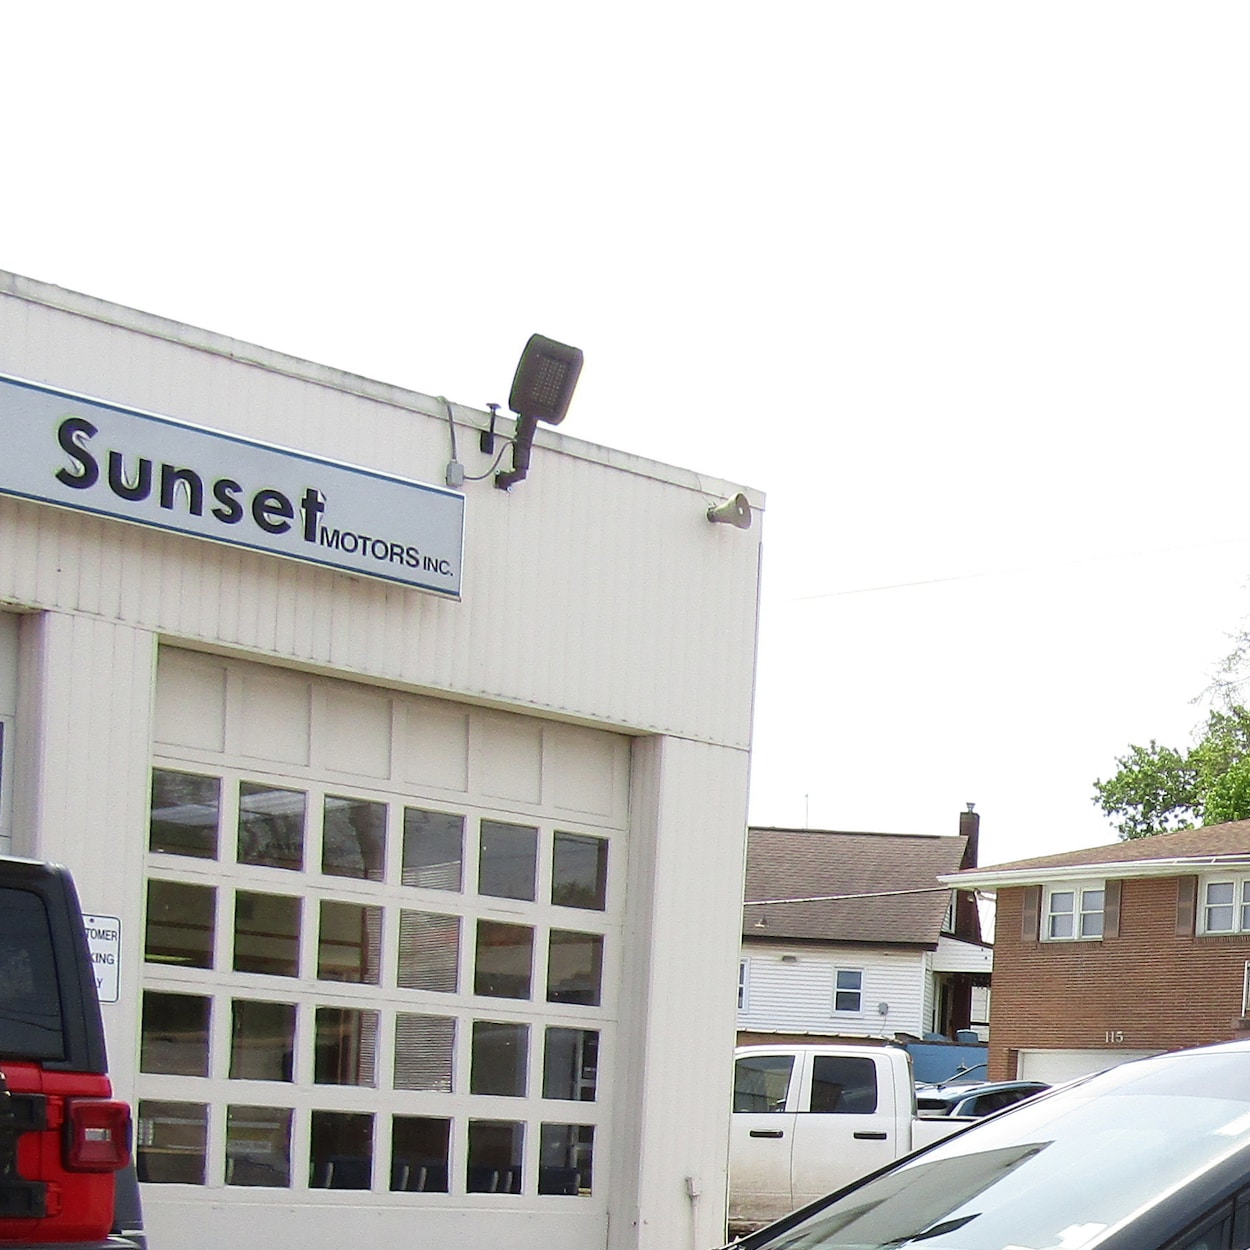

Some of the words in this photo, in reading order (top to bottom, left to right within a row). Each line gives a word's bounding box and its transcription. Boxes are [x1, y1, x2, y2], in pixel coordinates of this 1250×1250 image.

[54, 416, 324, 543] Sunset
[319, 525, 420, 569] MOTORS
[422, 555, 454, 577] INC.
[84, 927, 118, 941] TOMER
[91, 952, 115, 965] KING
[1105, 1030, 1124, 1043] 115
